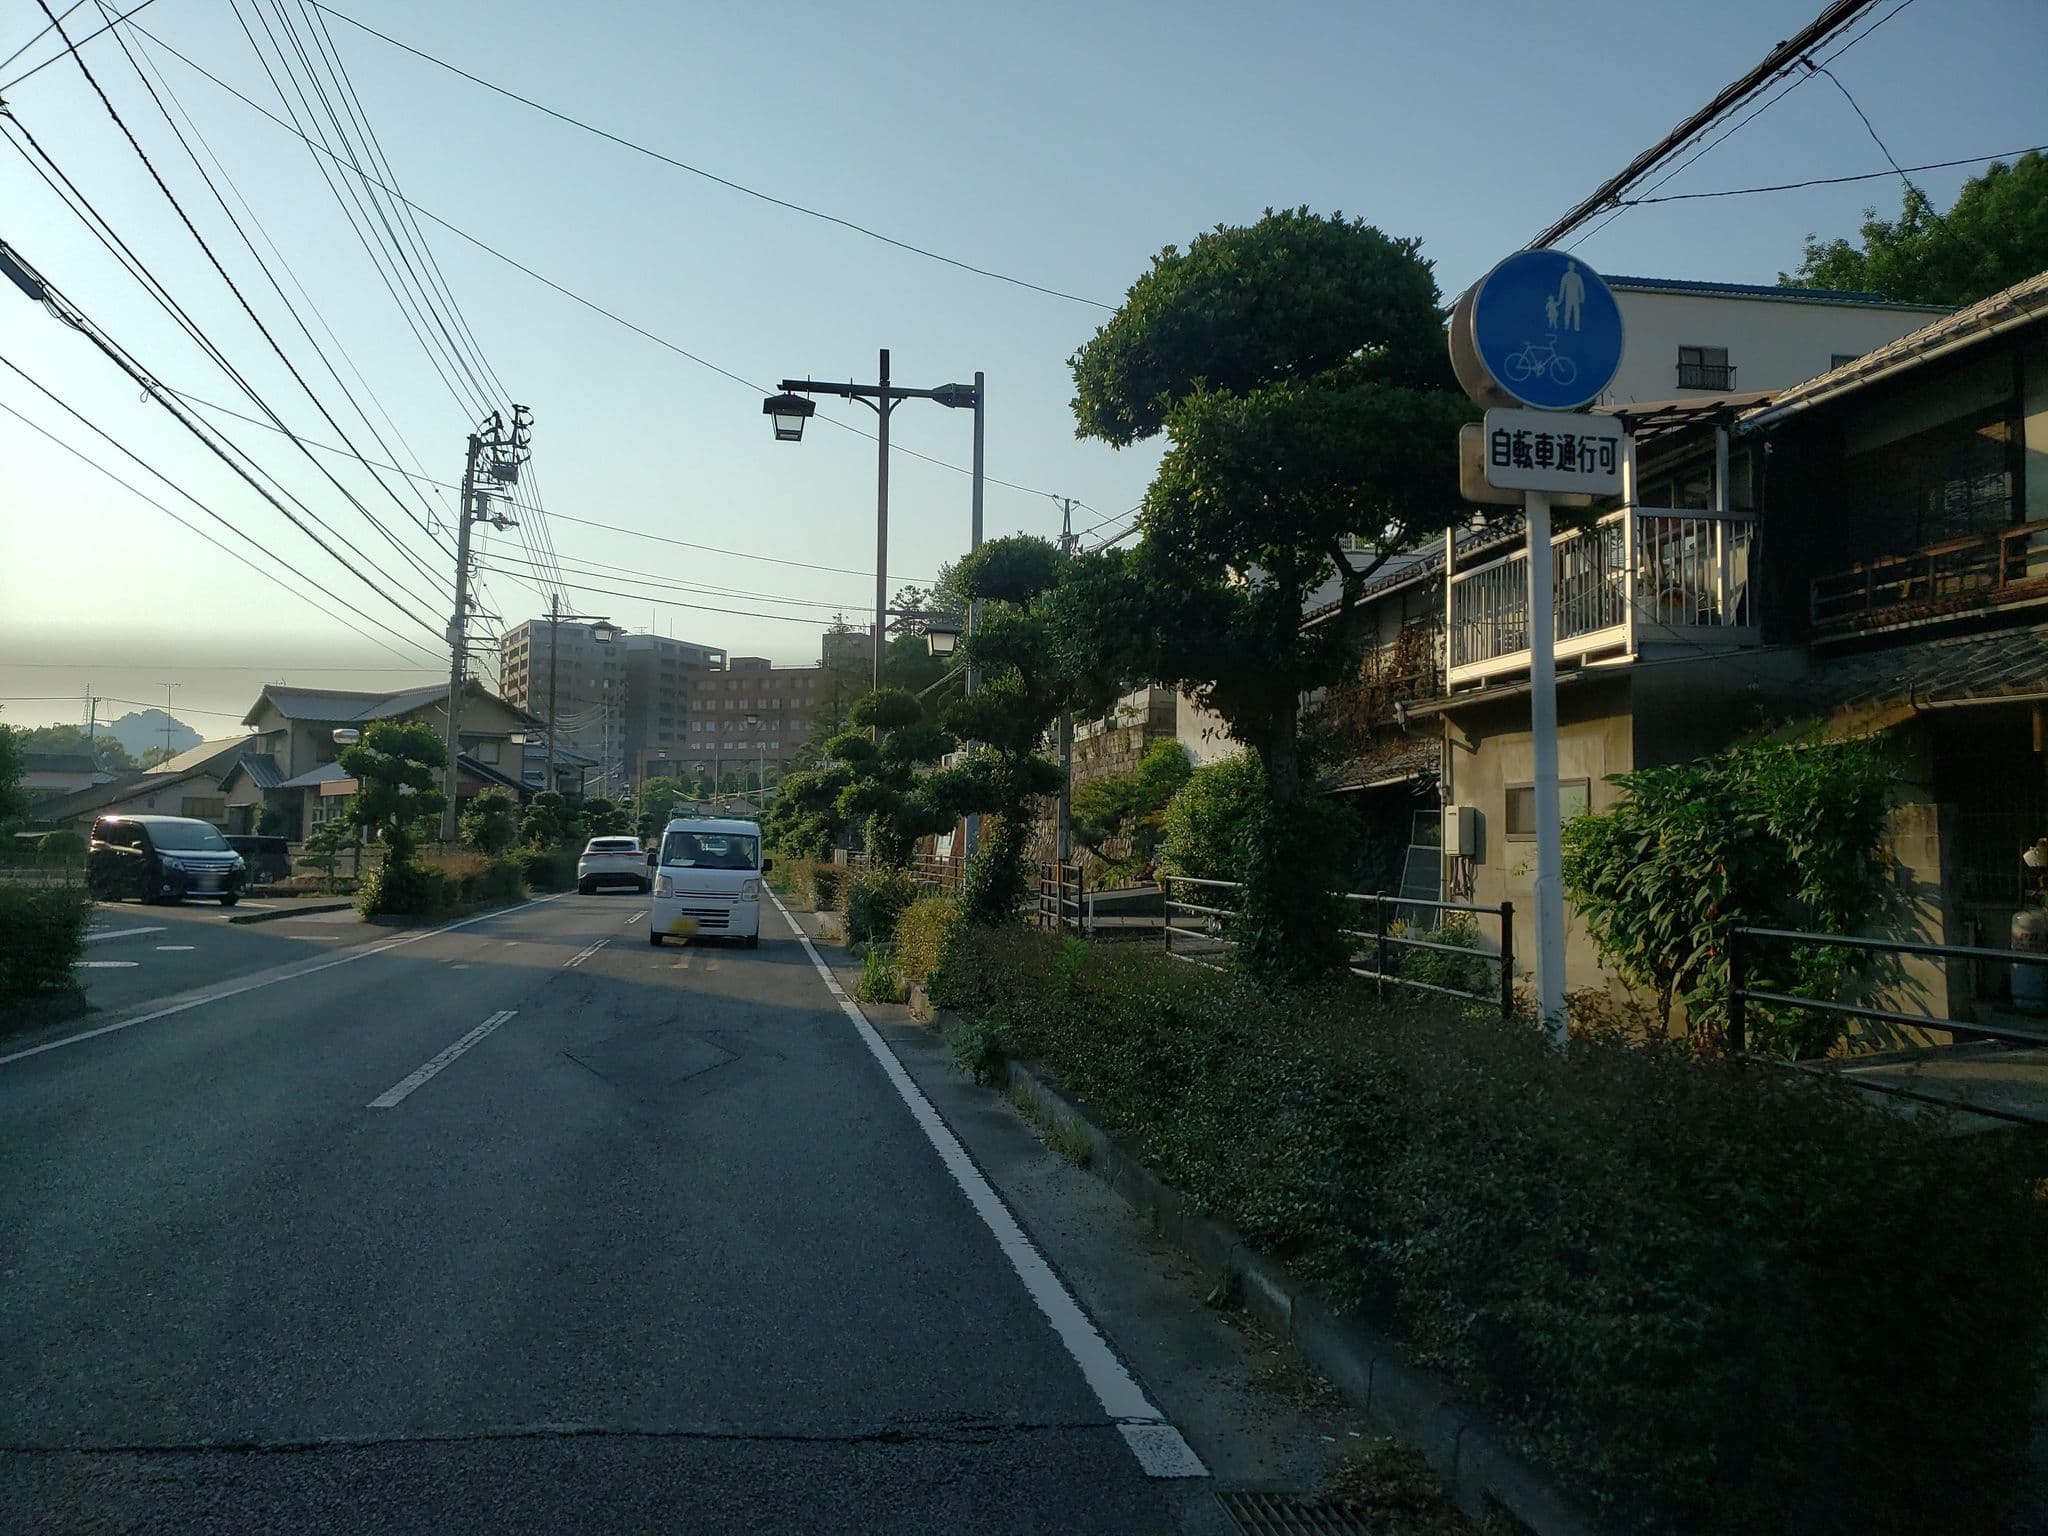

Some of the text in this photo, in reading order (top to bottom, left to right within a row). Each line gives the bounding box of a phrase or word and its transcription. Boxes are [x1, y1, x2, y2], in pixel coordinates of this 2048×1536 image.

[1491, 428, 1618, 475] 自転車通行可
